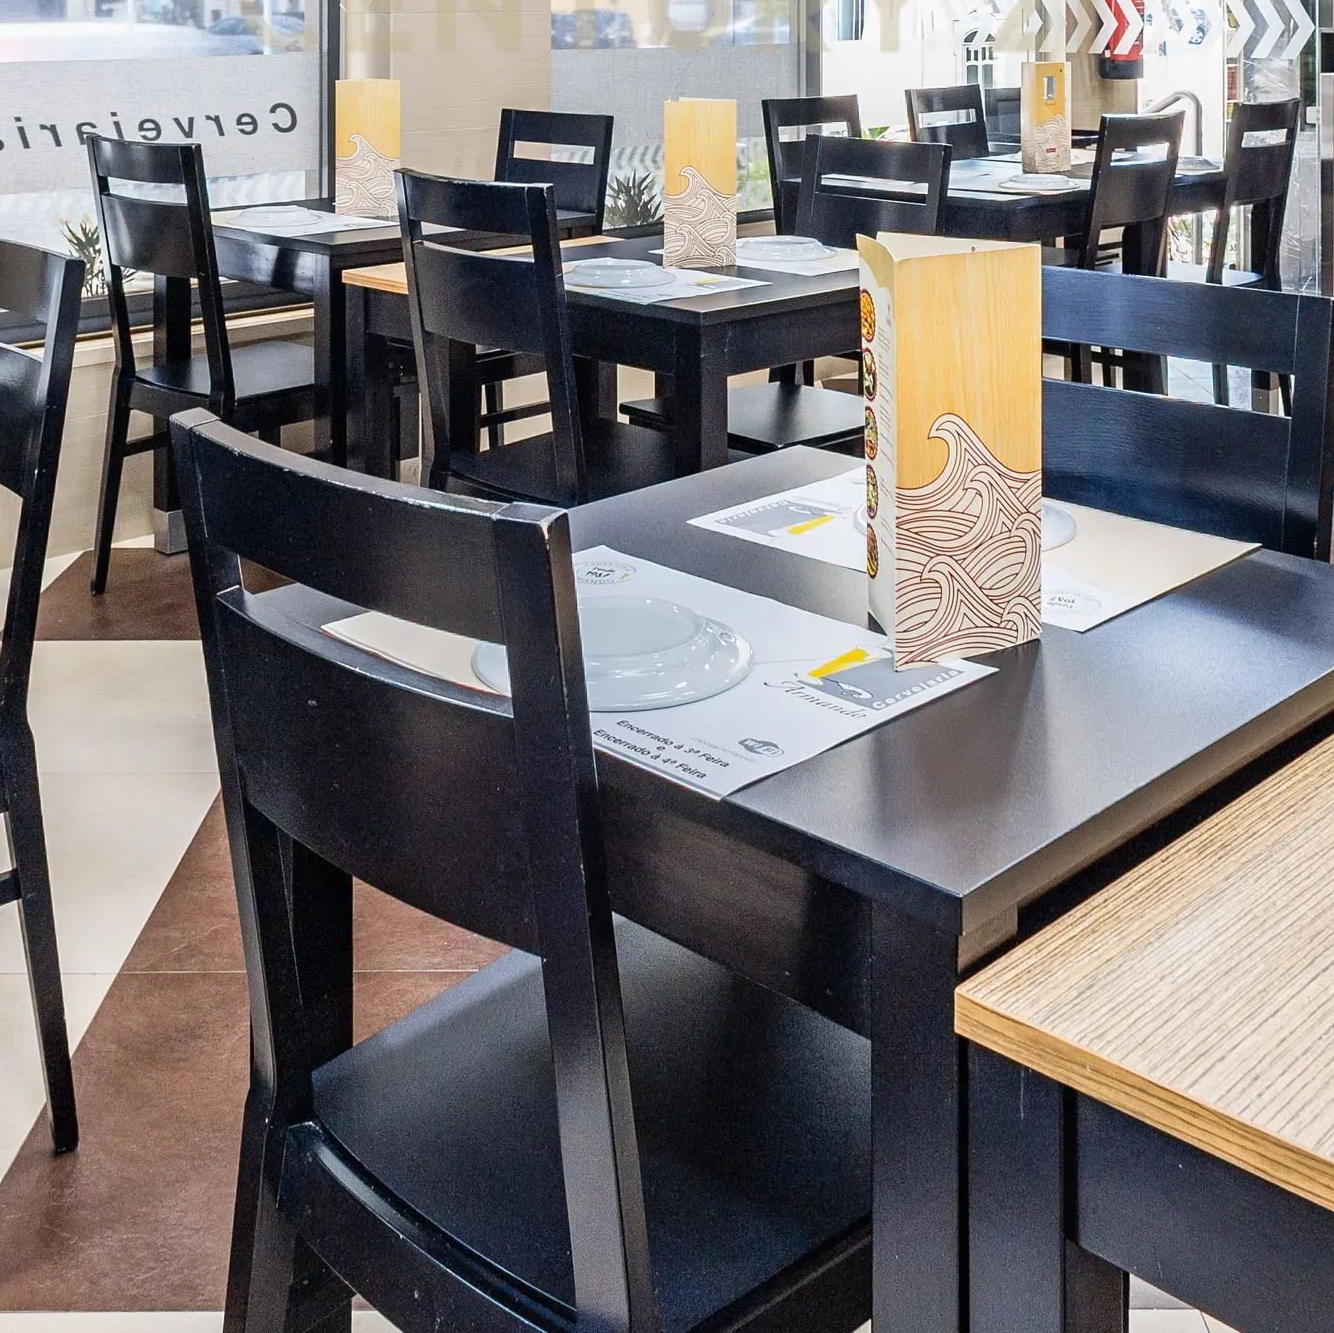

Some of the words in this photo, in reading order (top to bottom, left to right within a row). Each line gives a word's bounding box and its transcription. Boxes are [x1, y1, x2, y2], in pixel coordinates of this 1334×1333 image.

[764, 672, 867, 719] Armando
[872, 669, 961, 710] Cervejaria
[593, 729, 651, 756] Encerrado
[675, 762, 707, 779] Feira
[616, 719, 674, 747] Encerrado
[698, 753, 730, 768] Feira
